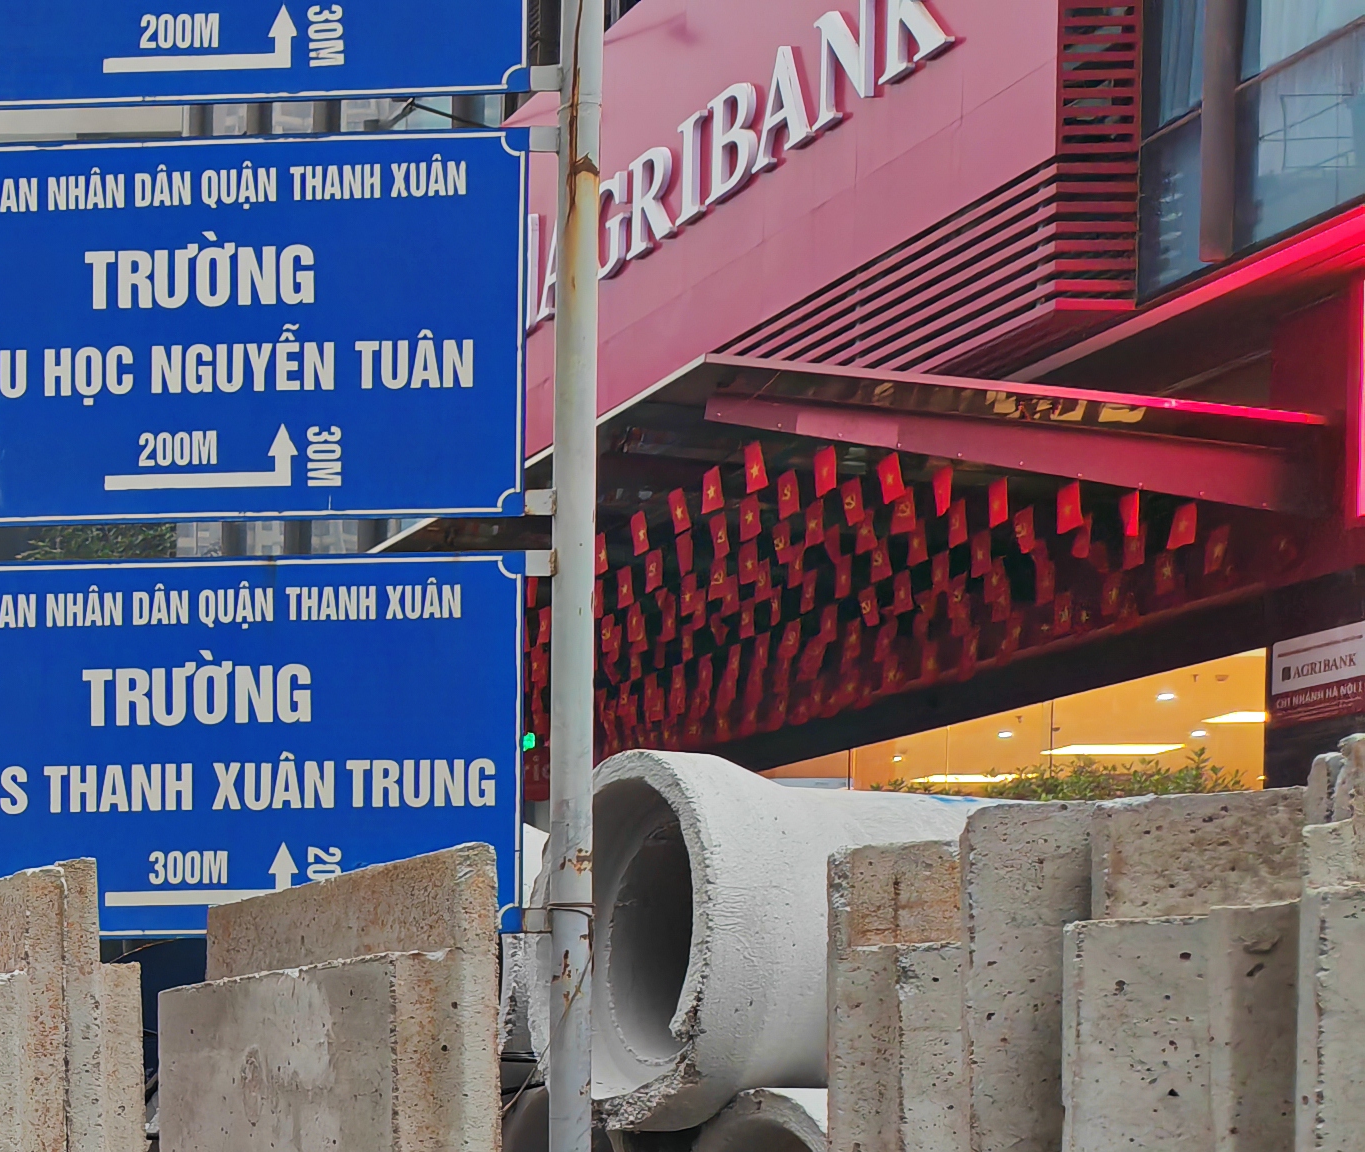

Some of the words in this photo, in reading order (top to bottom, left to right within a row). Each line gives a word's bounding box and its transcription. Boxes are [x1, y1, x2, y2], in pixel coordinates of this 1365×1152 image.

[139, 12, 220, 49] 200M
[307, 4, 345, 68] 30M
[47, 168, 125, 211] NHÂN
[134, 165, 192, 208] DÂN
[200, 161, 277, 210] QUẬN
[290, 163, 381, 201] THANH
[390, 154, 467, 198] XUÂN
[85, 231, 315, 310] TRƯỜNG
[44, 346, 134, 406] HỌC
[151, 324, 335, 394] NGUYỄN
[355, 330, 474, 390] TUÂN
[139, 431, 218, 467] 200M
[306, 425, 342, 488] 30M
[46, 586, 123, 628] NHÂN
[132, 584, 189, 626] DÂN
[198, 581, 274, 630] QUẬN
[286, 585, 377, 621] THANH
[386, 578, 462, 620] XUÂN
[83, 650, 312, 727] TRƯỜNG
[1293, 652, 1357, 680] AGRIBANK
[43, 763, 193, 814] THANH
[213, 752, 335, 811] XUÂN
[345, 758, 496, 808] TRUNG
[148, 850, 229, 886] 300M
